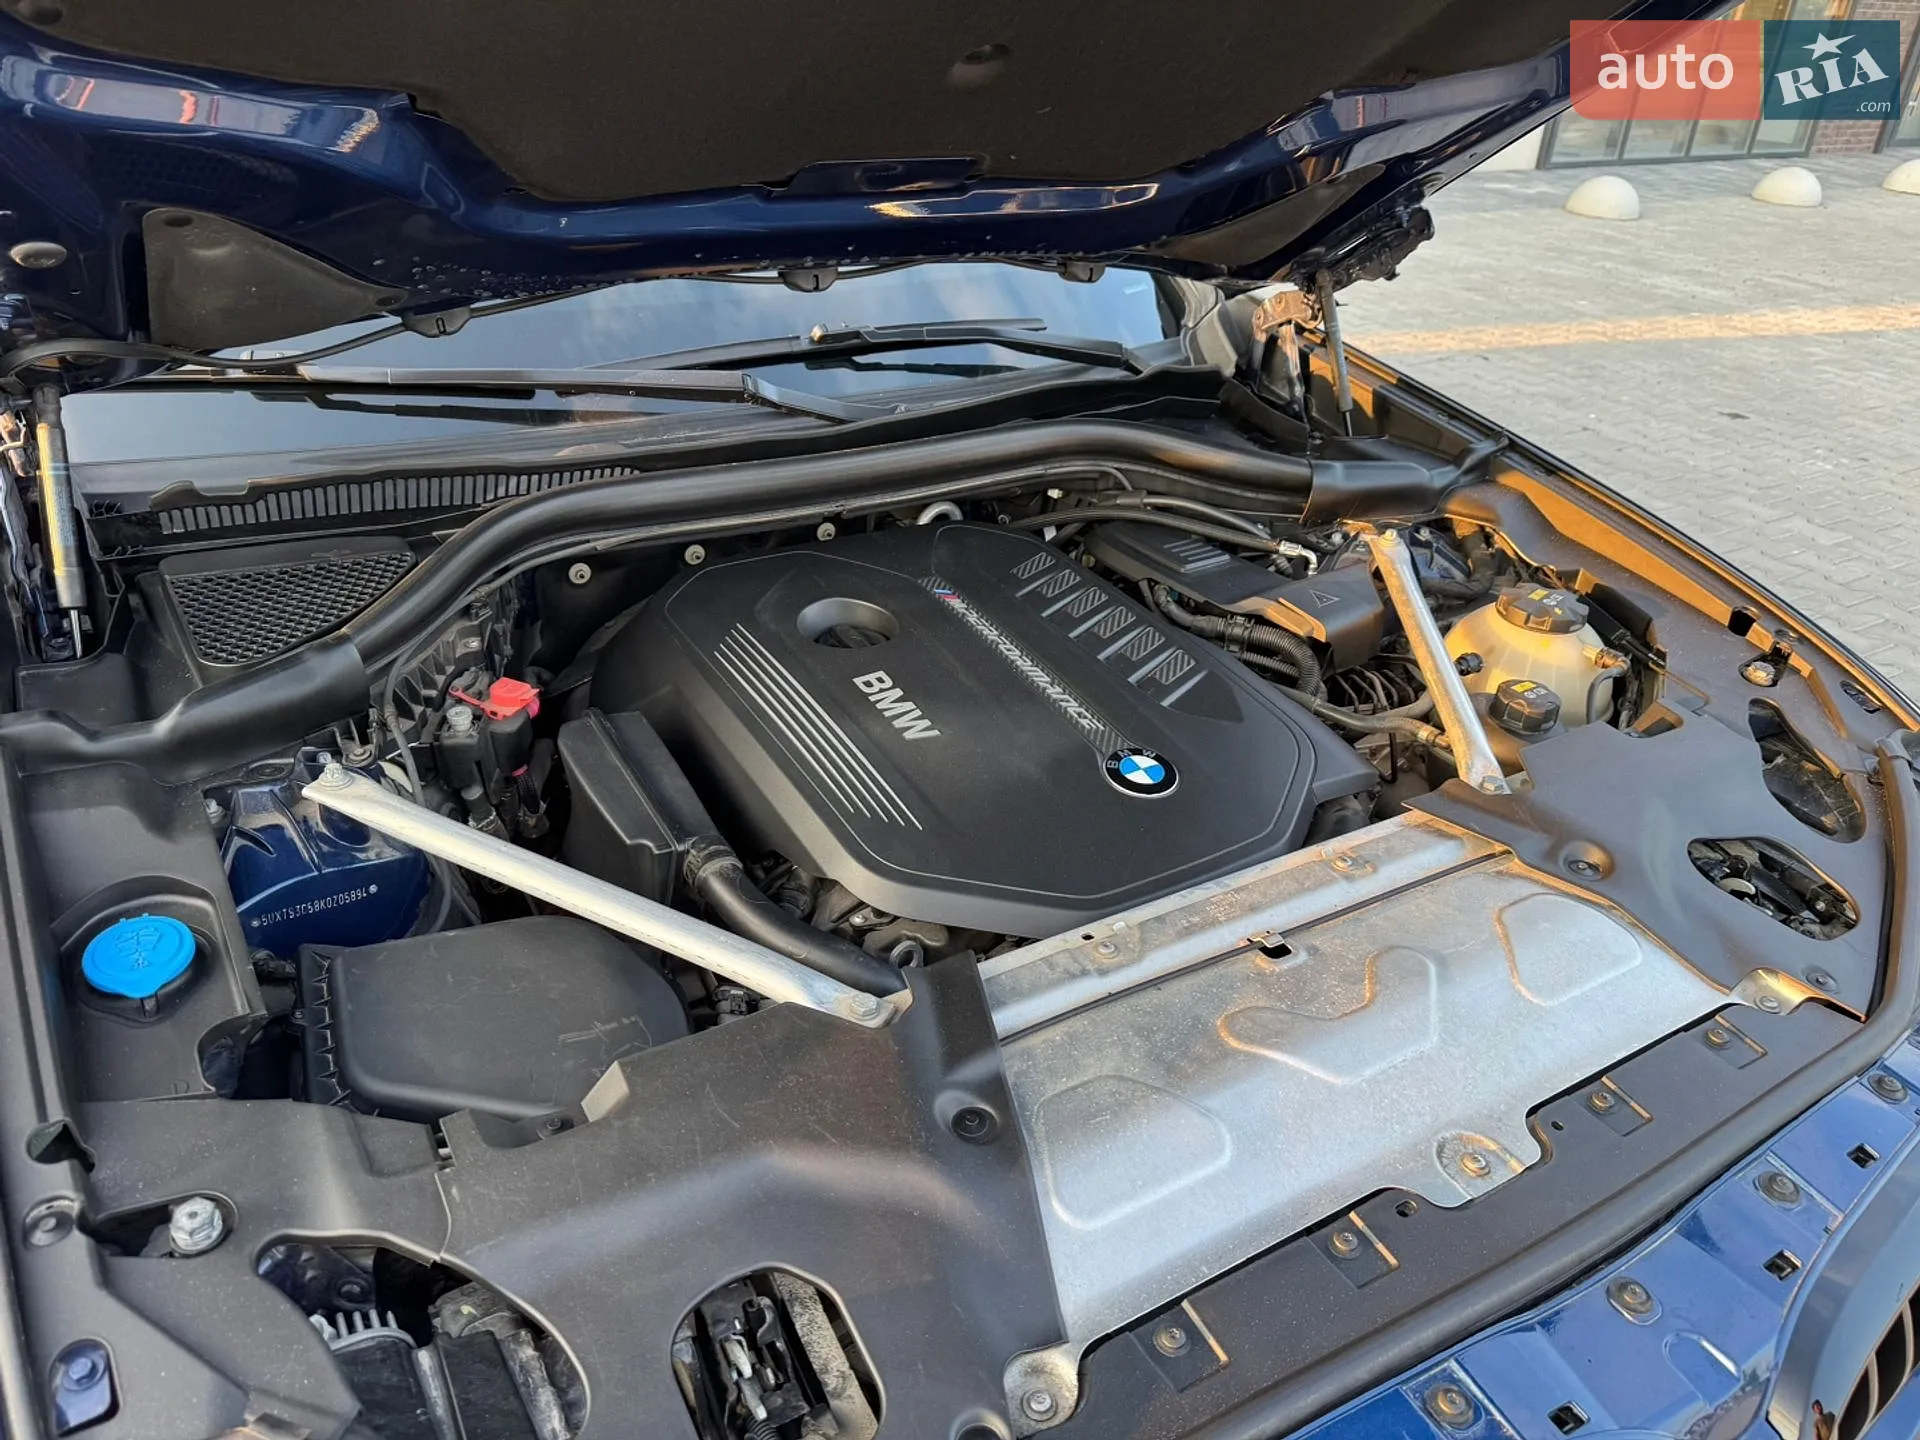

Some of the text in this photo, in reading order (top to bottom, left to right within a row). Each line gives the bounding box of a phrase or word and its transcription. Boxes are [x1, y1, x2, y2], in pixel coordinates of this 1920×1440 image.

[957, 608, 1104, 729] PERFORMANCE
[852, 670, 941, 741] BMW
[1107, 749, 1156, 768] BMW
